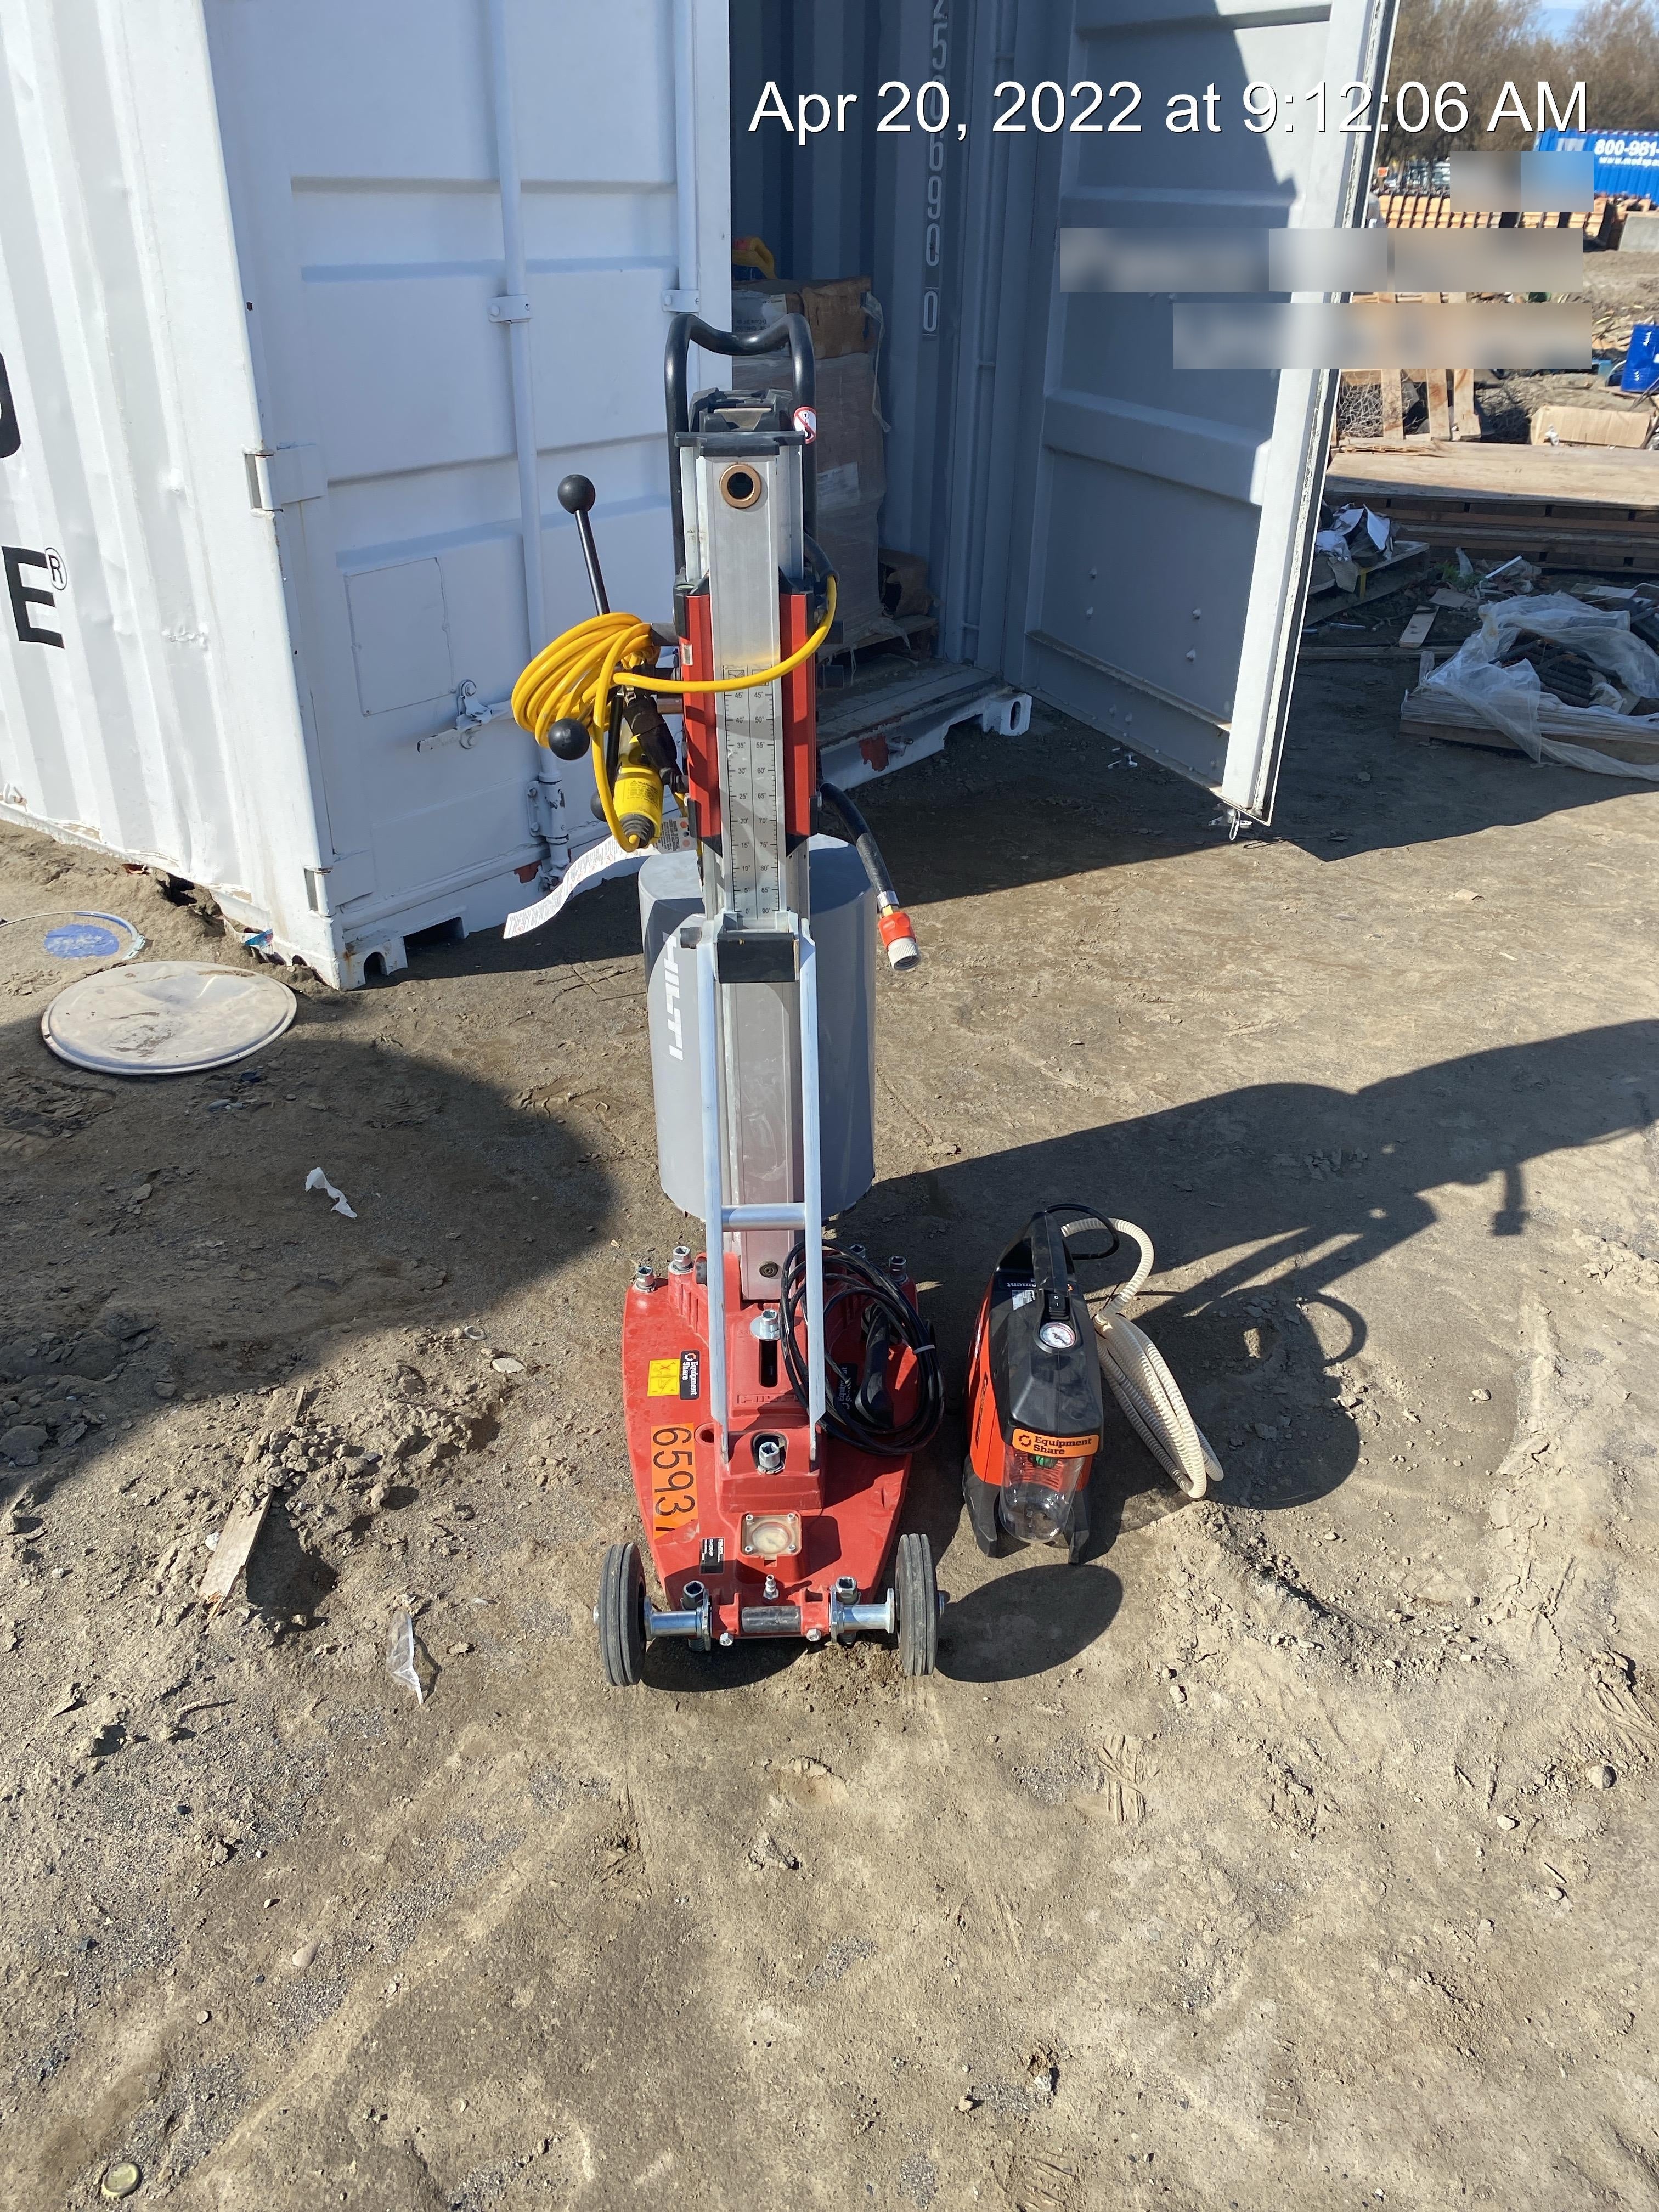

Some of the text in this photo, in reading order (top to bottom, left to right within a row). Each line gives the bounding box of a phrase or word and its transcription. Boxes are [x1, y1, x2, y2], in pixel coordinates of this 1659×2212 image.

[662, 932, 684, 1061] HILTI
[690, 1361, 698, 1396] Equipment
[1034, 1444, 1065, 1454] Share
[1035, 1436, 1092, 1448] Equipment
